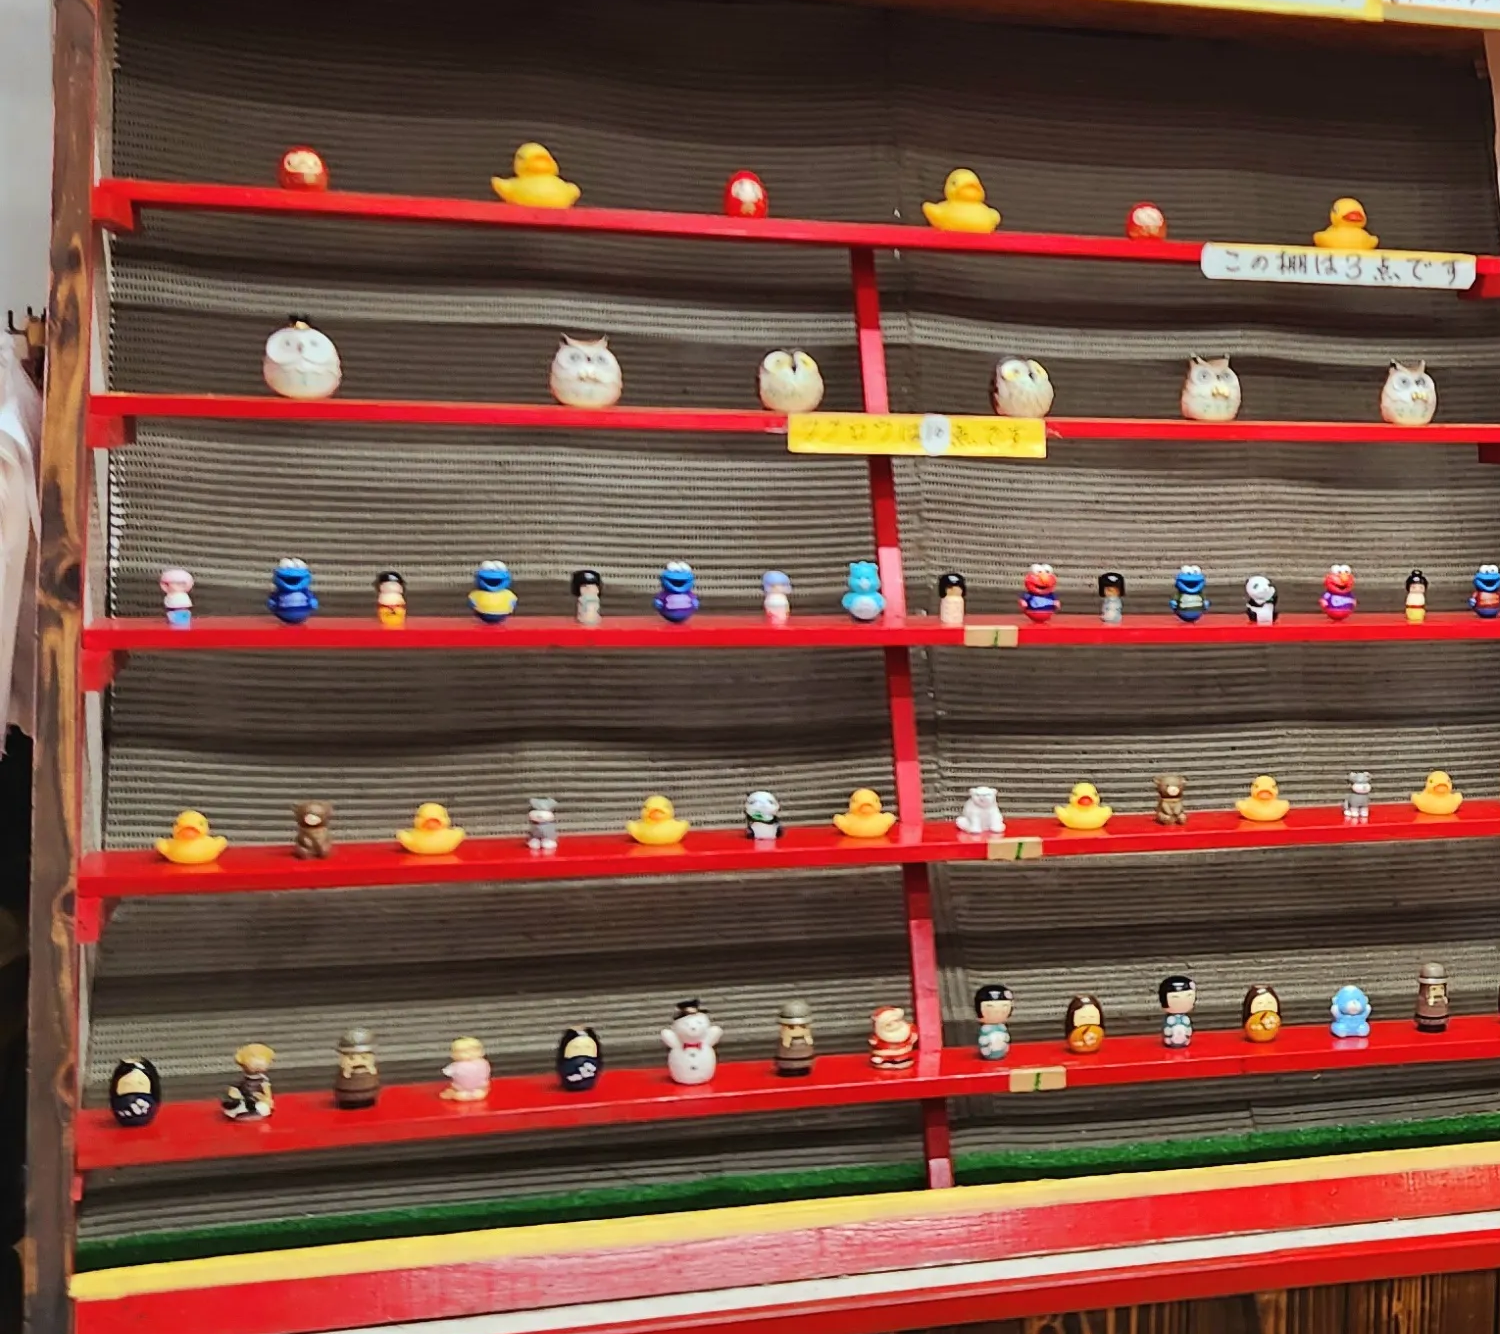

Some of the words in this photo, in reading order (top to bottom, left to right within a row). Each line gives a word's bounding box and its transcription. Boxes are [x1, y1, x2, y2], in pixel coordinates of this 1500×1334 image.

[1224, 248, 1461, 285] この棚は3点です
